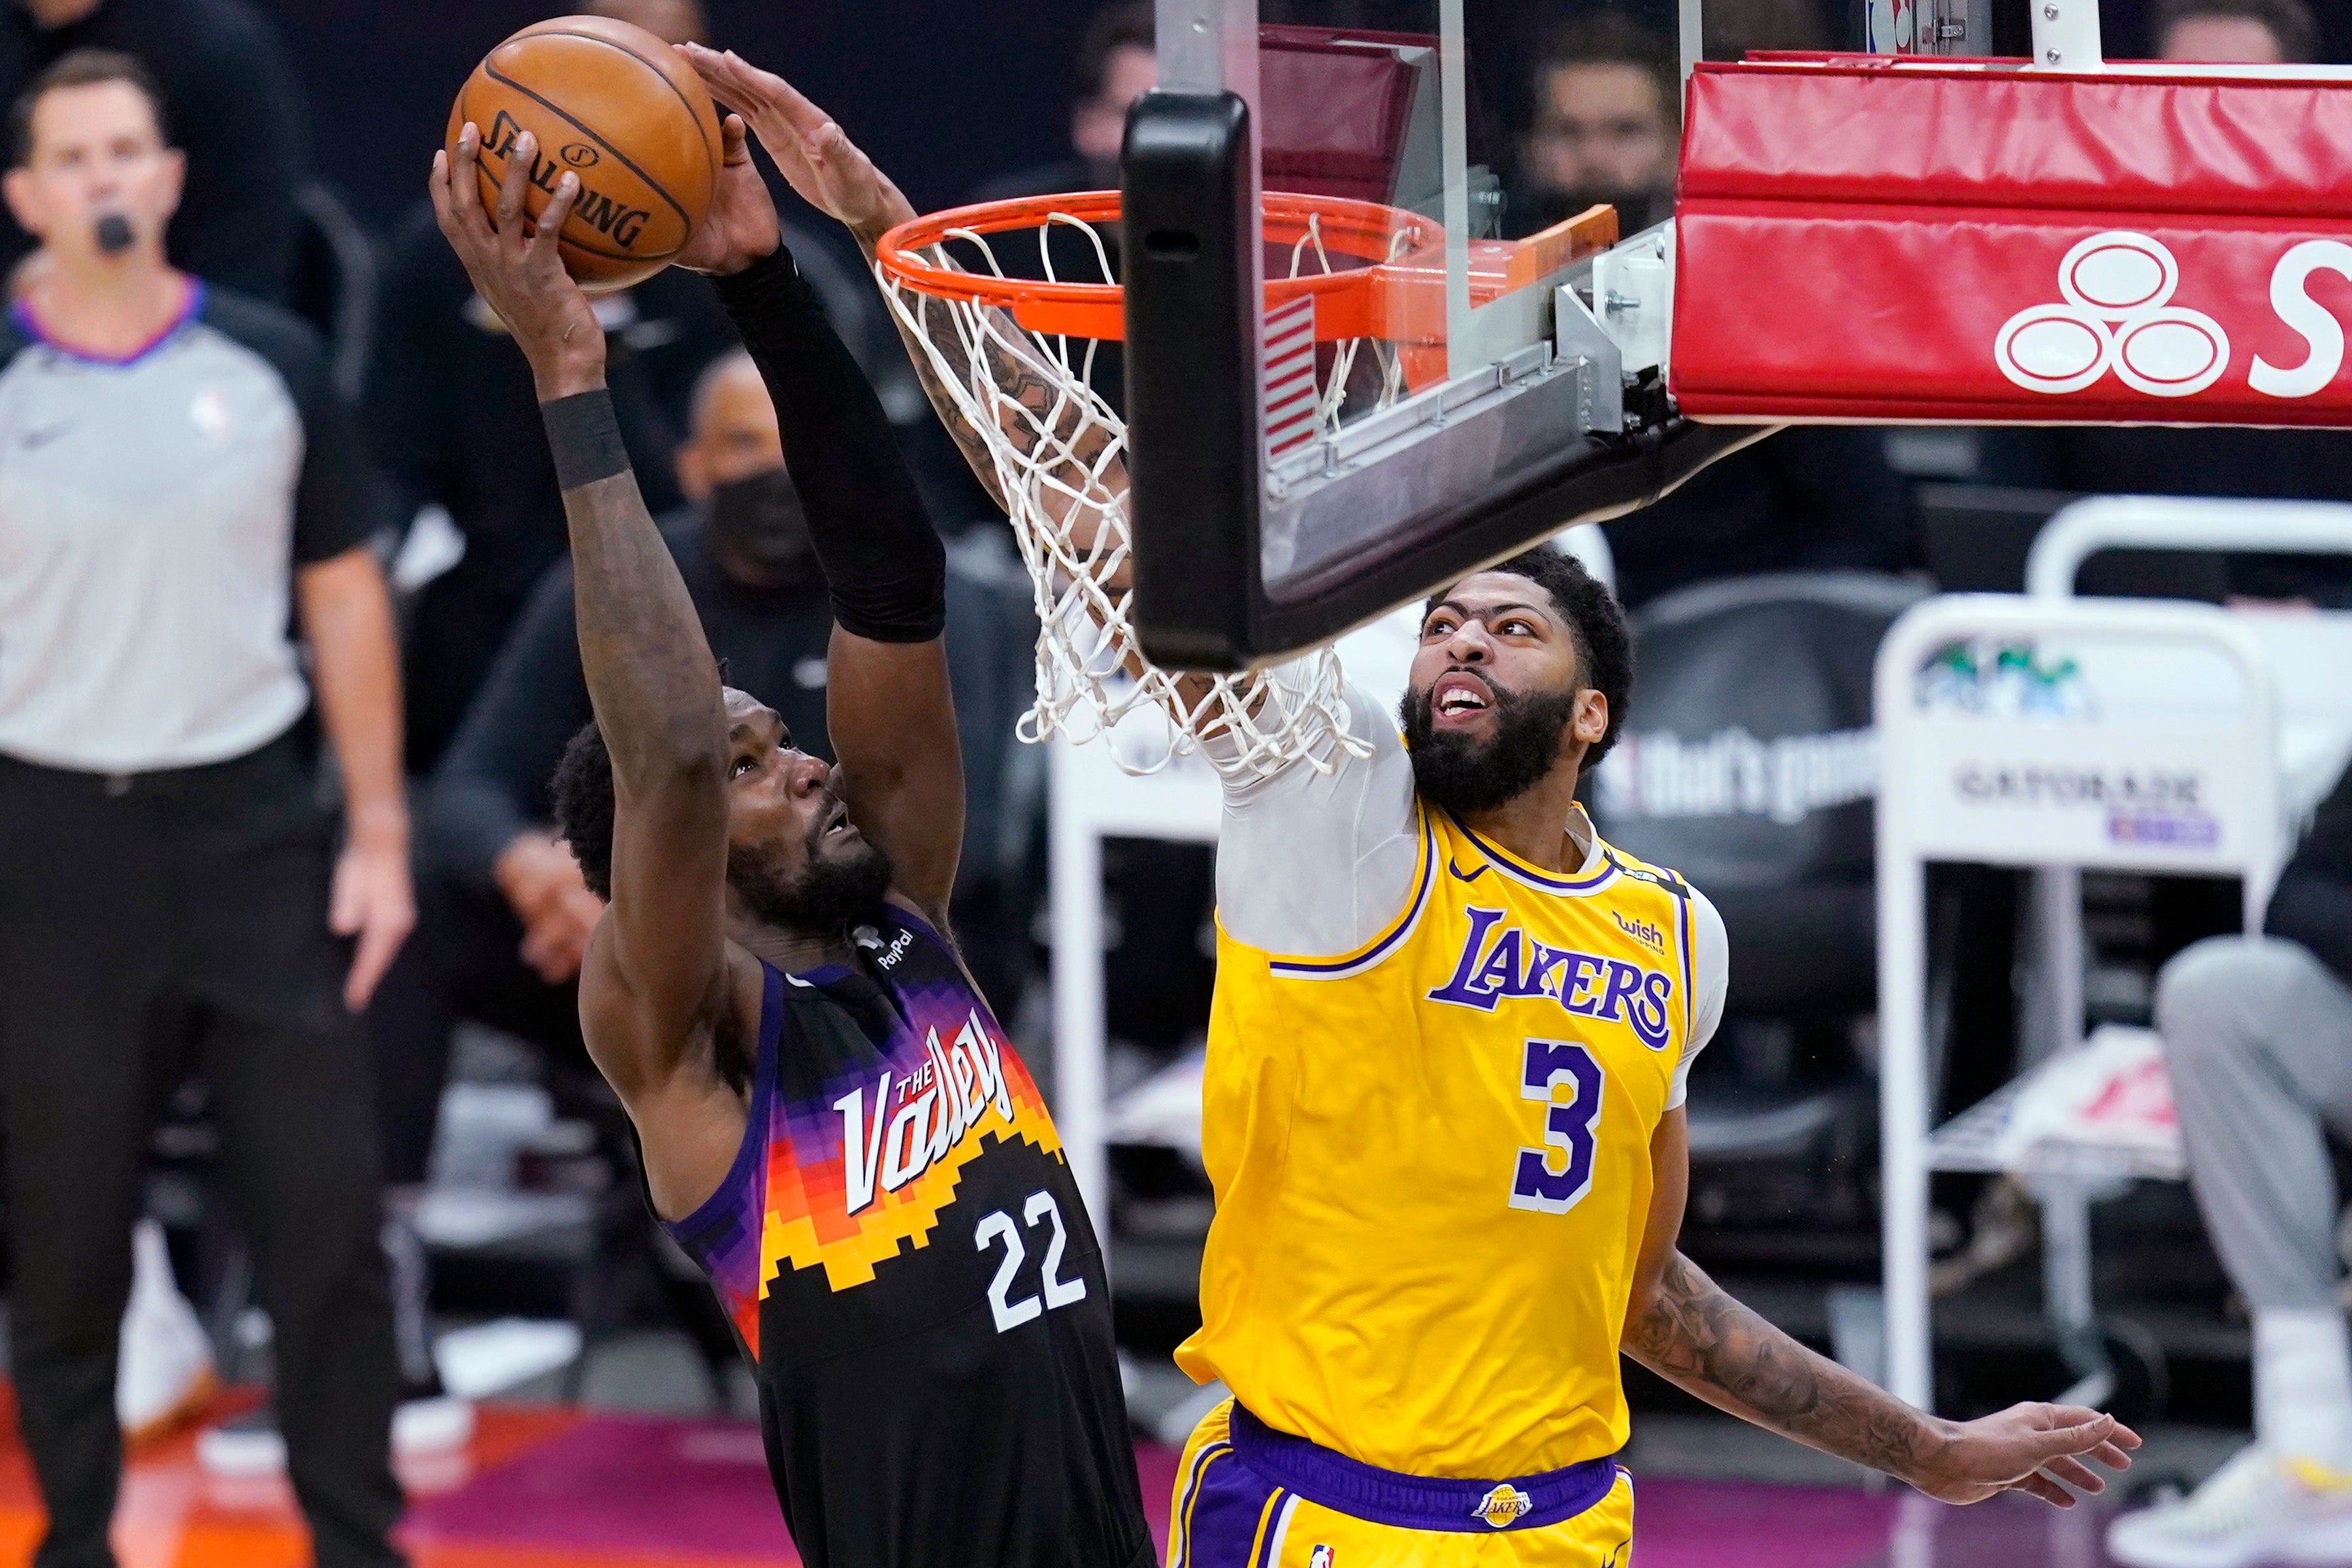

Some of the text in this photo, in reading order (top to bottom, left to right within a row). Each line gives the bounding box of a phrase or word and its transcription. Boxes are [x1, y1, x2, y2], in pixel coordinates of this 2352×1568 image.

[2247, 239, 2352, 399] S
[877, 928, 914, 970] PayPal
[1424, 903, 1673, 1052] LAKERS
[1612, 909, 1663, 947] wish
[832, 1007, 1015, 1217] Valley
[896, 1059, 934, 1104] THE
[1508, 1036, 1606, 1215] 3
[973, 1188, 1087, 1334] 22
[1475, 1497, 1529, 1516] LAKERS
